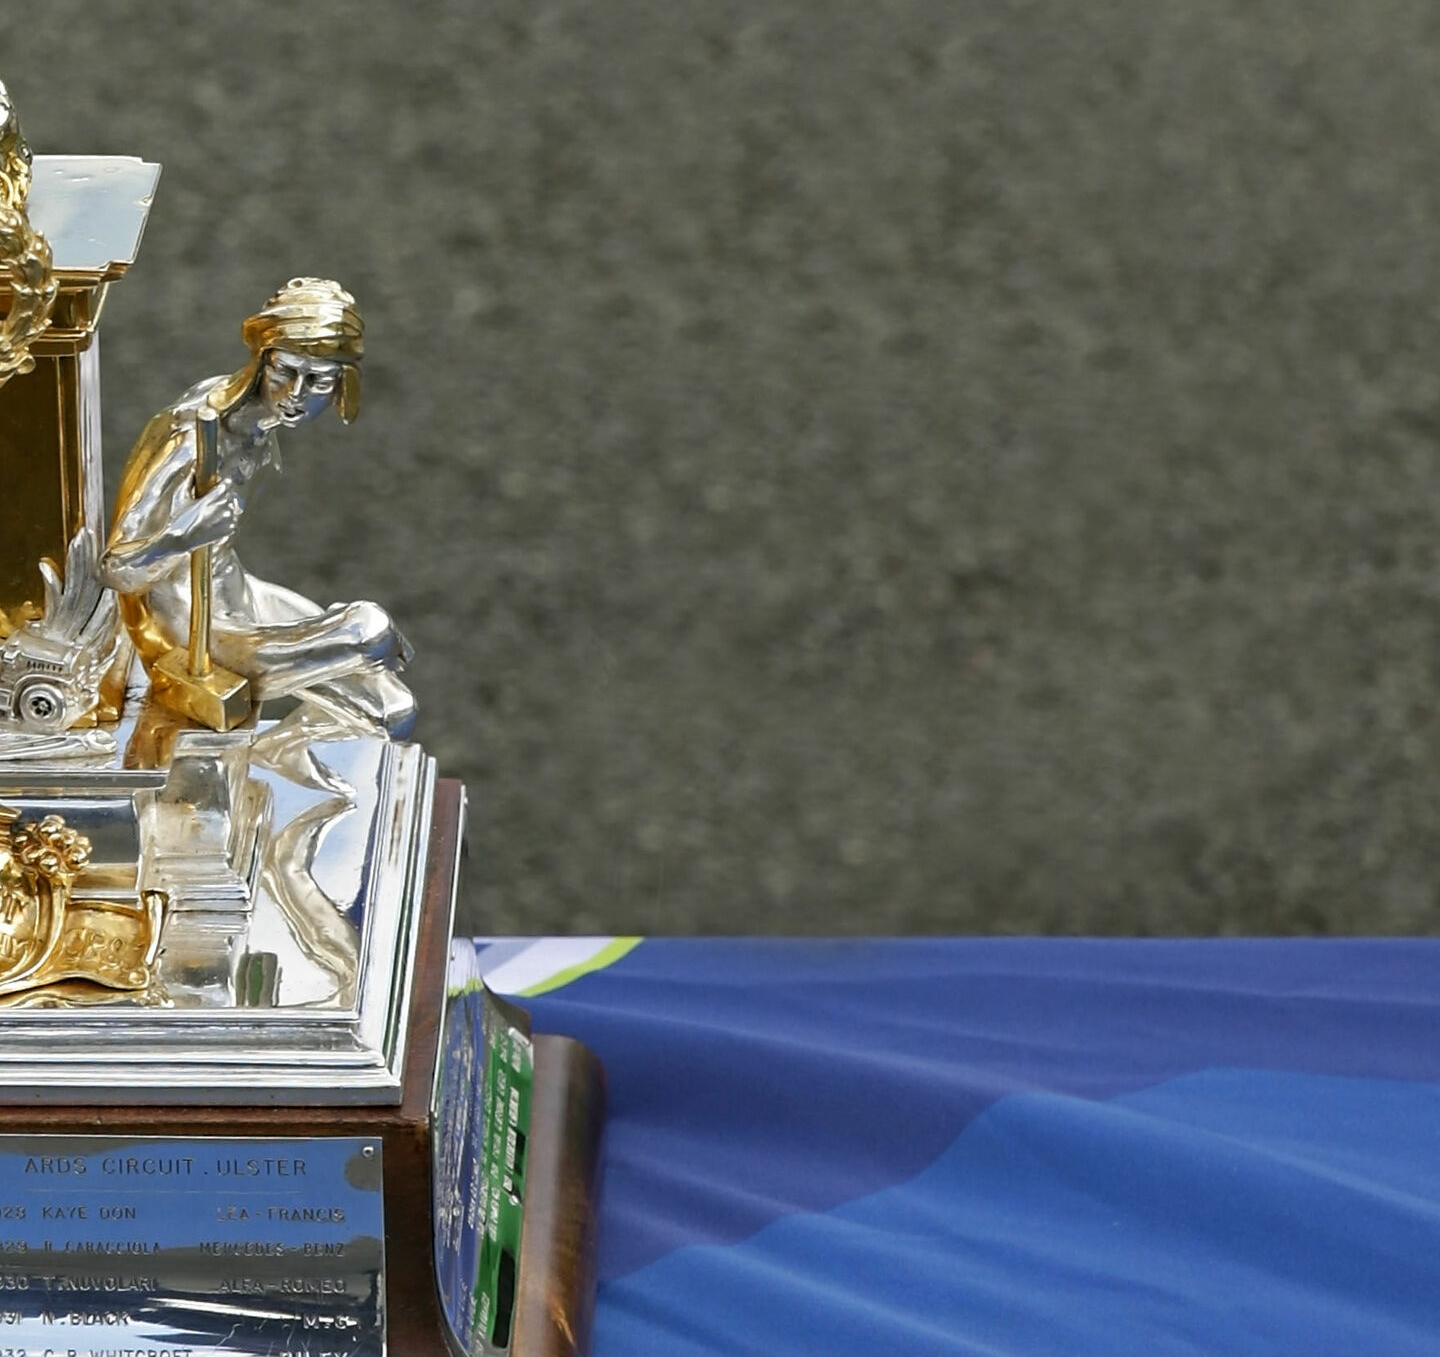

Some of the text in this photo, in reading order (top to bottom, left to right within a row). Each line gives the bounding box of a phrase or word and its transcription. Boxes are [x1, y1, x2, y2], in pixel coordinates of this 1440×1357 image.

[24, 1157, 87, 1174] ARDS
[216, 1159, 307, 1176] ULSTER
[42, 1206, 89, 1220] KAYE
[99, 1206, 137, 1220] DON
